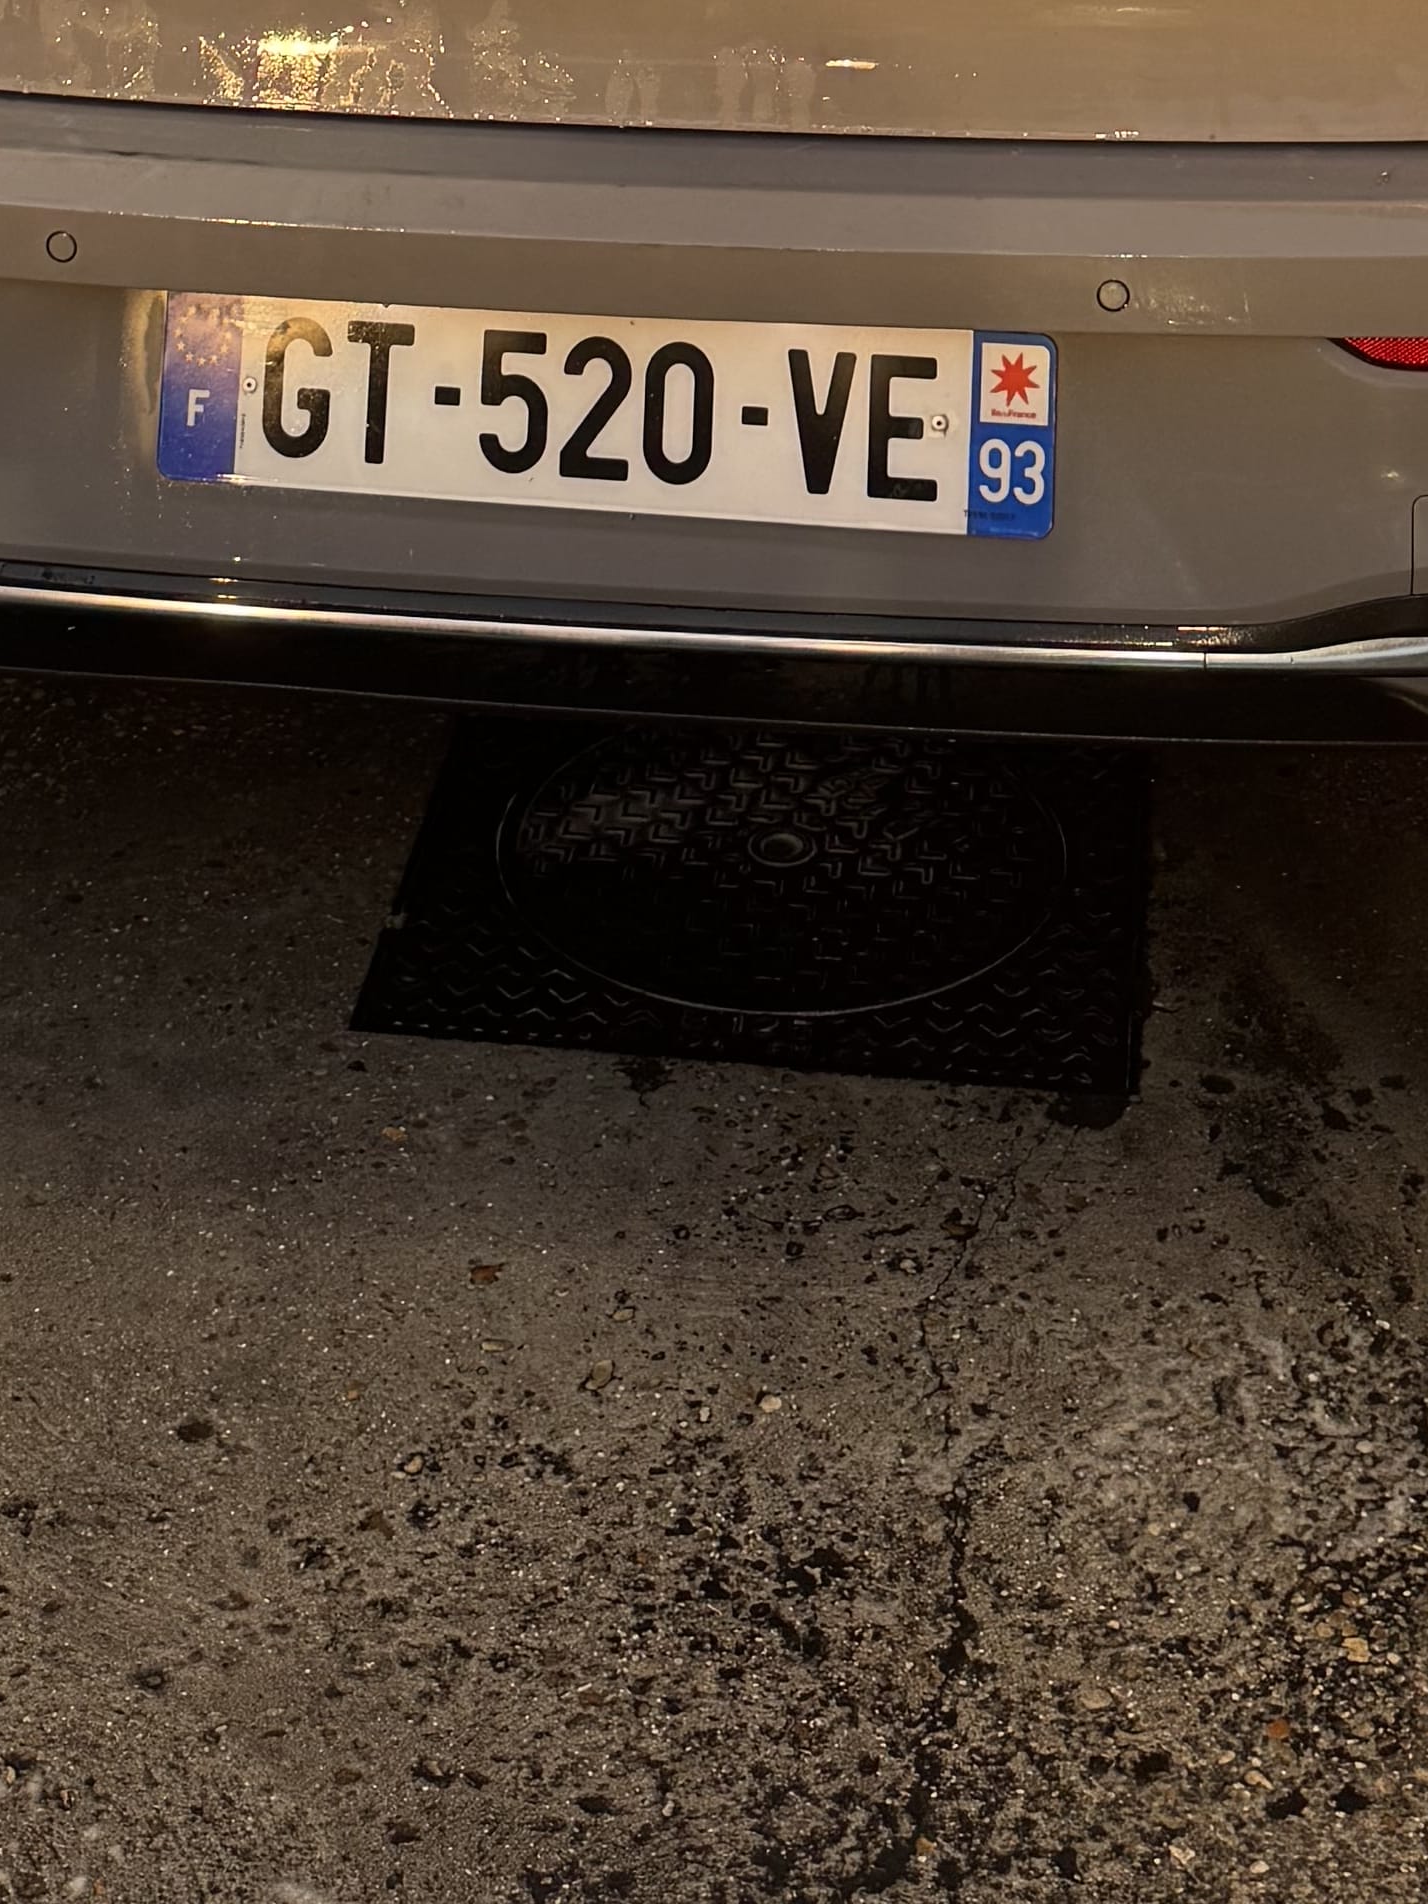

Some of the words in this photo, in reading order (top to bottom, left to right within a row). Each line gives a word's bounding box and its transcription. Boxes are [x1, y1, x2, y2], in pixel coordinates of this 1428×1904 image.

[186, 388, 211, 427] F
[261, 316, 938, 503] GT-520-VE
[978, 437, 1047, 506] 93
